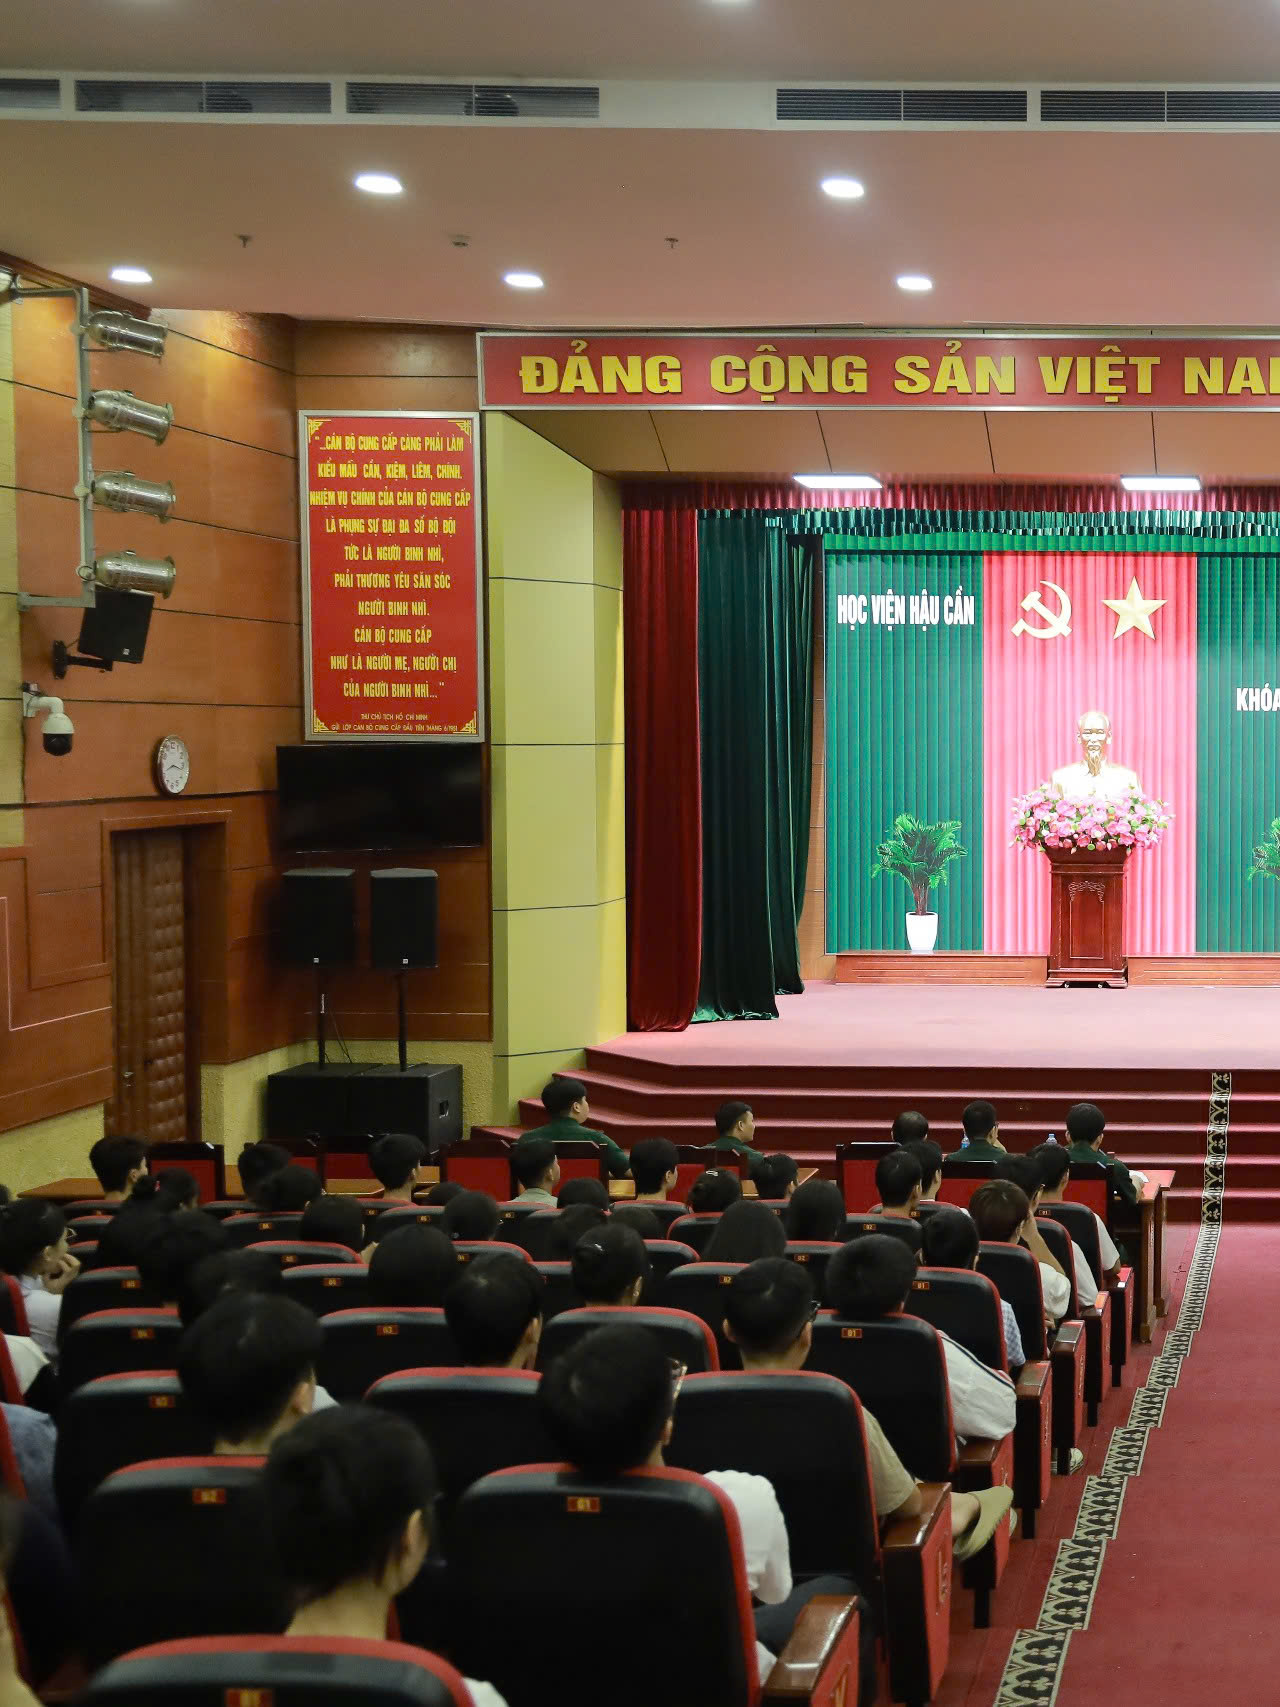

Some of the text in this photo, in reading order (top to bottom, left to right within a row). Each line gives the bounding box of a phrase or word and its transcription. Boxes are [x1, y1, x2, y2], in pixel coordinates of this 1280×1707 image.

[519, 341, 681, 393] ĐẢNG
[711, 345, 867, 401] CỘNG
[895, 341, 1022, 396] SẢN
[1039, 346, 1160, 402] VIỆT
[838, 595, 867, 630] HỌC
[872, 589, 905, 631] VIỆN
[910, 589, 939, 631] HẬU
